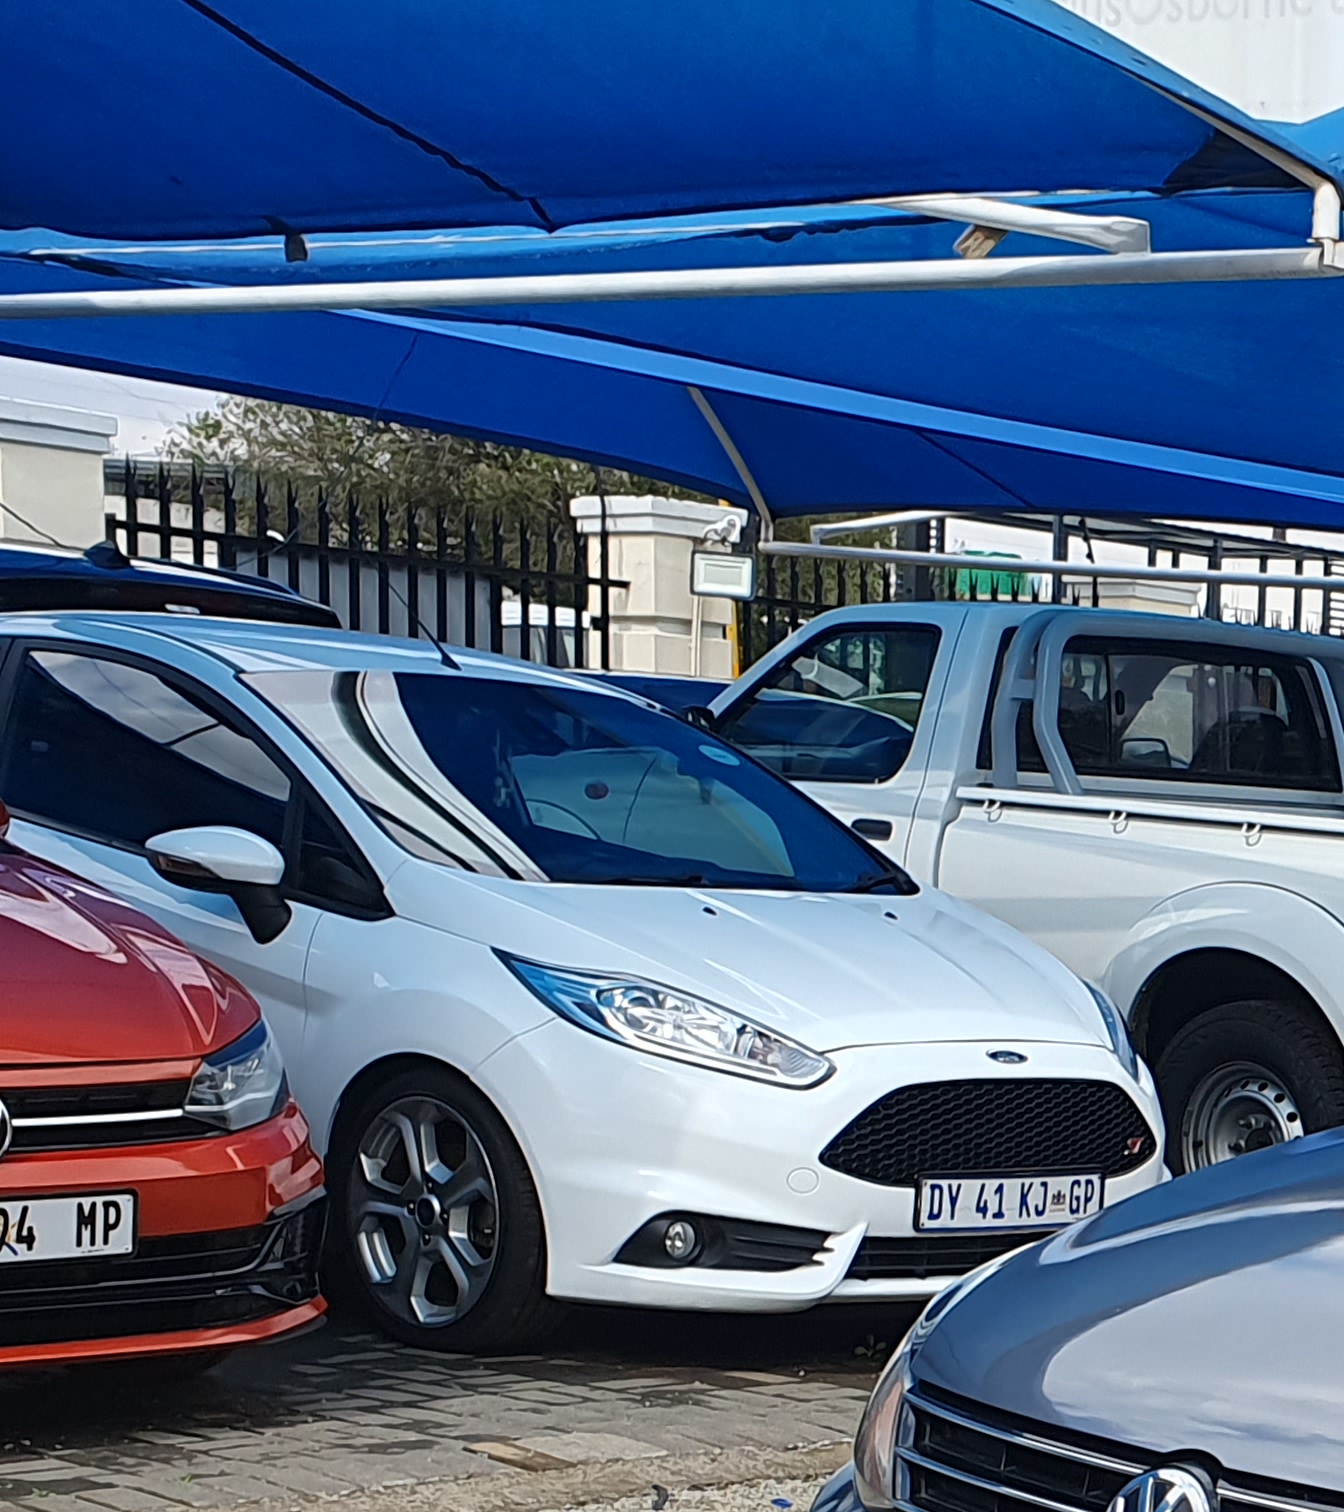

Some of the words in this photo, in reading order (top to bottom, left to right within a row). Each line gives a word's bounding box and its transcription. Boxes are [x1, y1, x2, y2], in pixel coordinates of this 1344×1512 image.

[927, 1183, 962, 1221] DY
[975, 1182, 1005, 1220] 41
[1018, 1180, 1049, 1219] KJ
[1069, 1178, 1095, 1216] GP
[76, 1199, 122, 1248] MP
